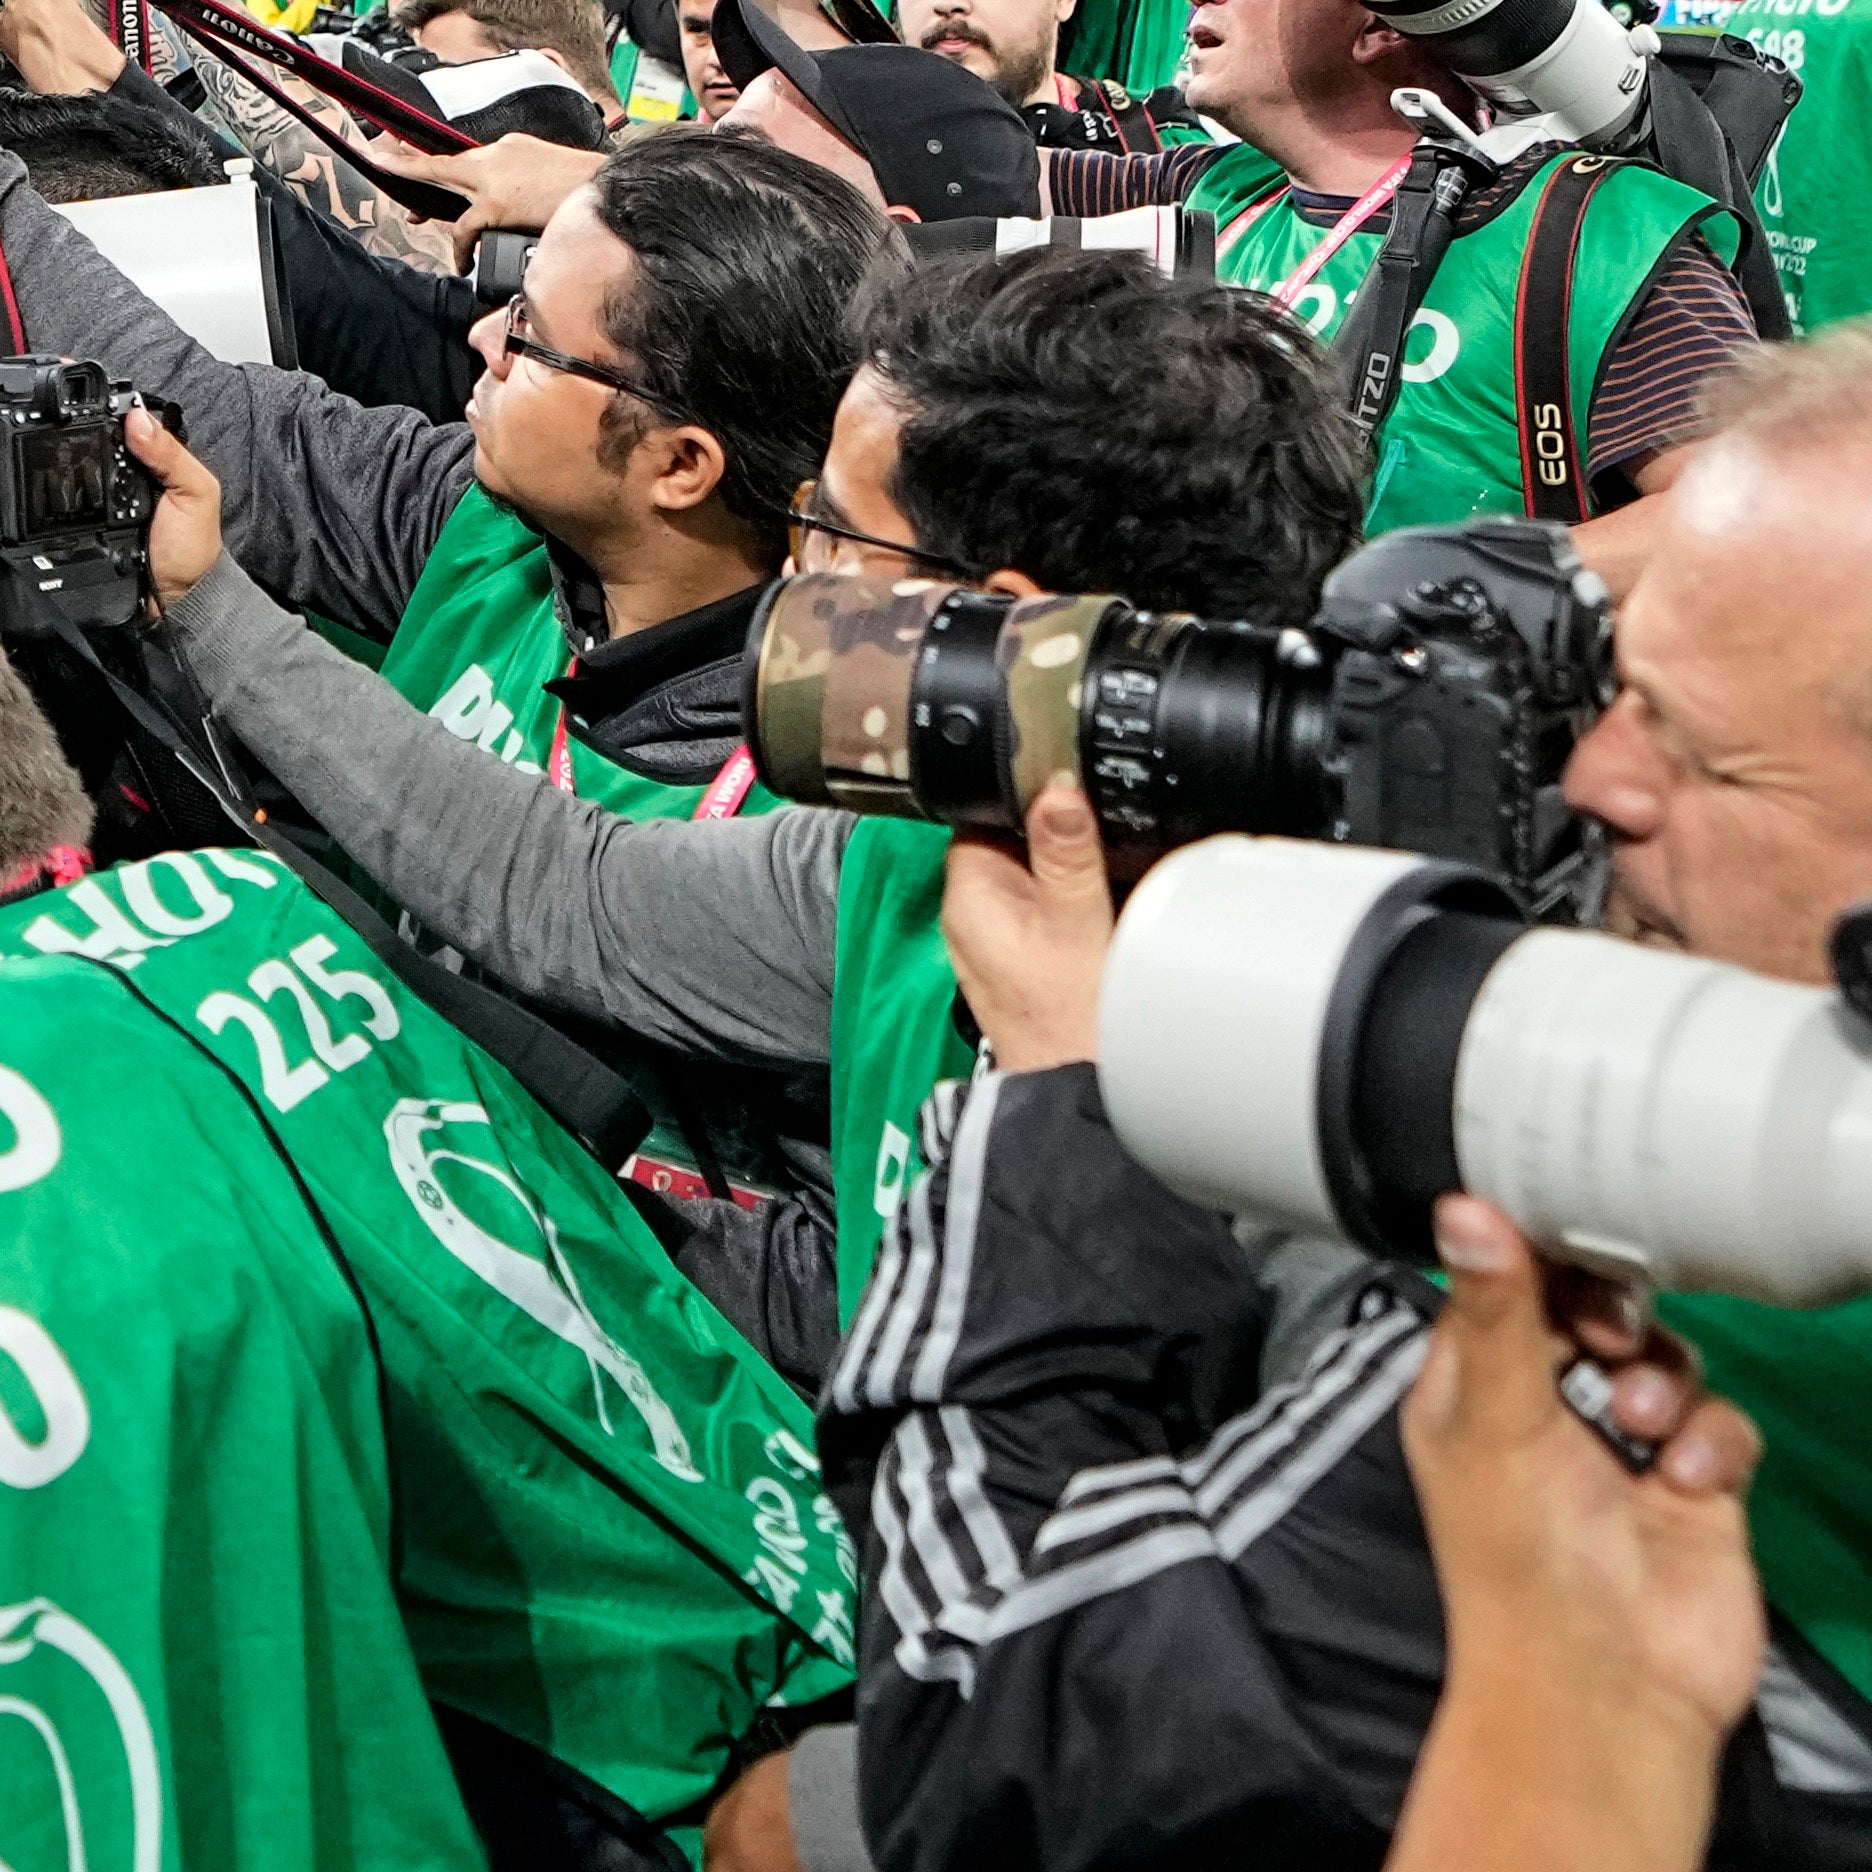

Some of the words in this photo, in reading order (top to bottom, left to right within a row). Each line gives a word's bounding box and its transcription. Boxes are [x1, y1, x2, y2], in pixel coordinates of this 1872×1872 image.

[122, 0, 140, 59] anon
[1534, 403, 1566, 485] EOS
[195, 933, 400, 1114] 225
